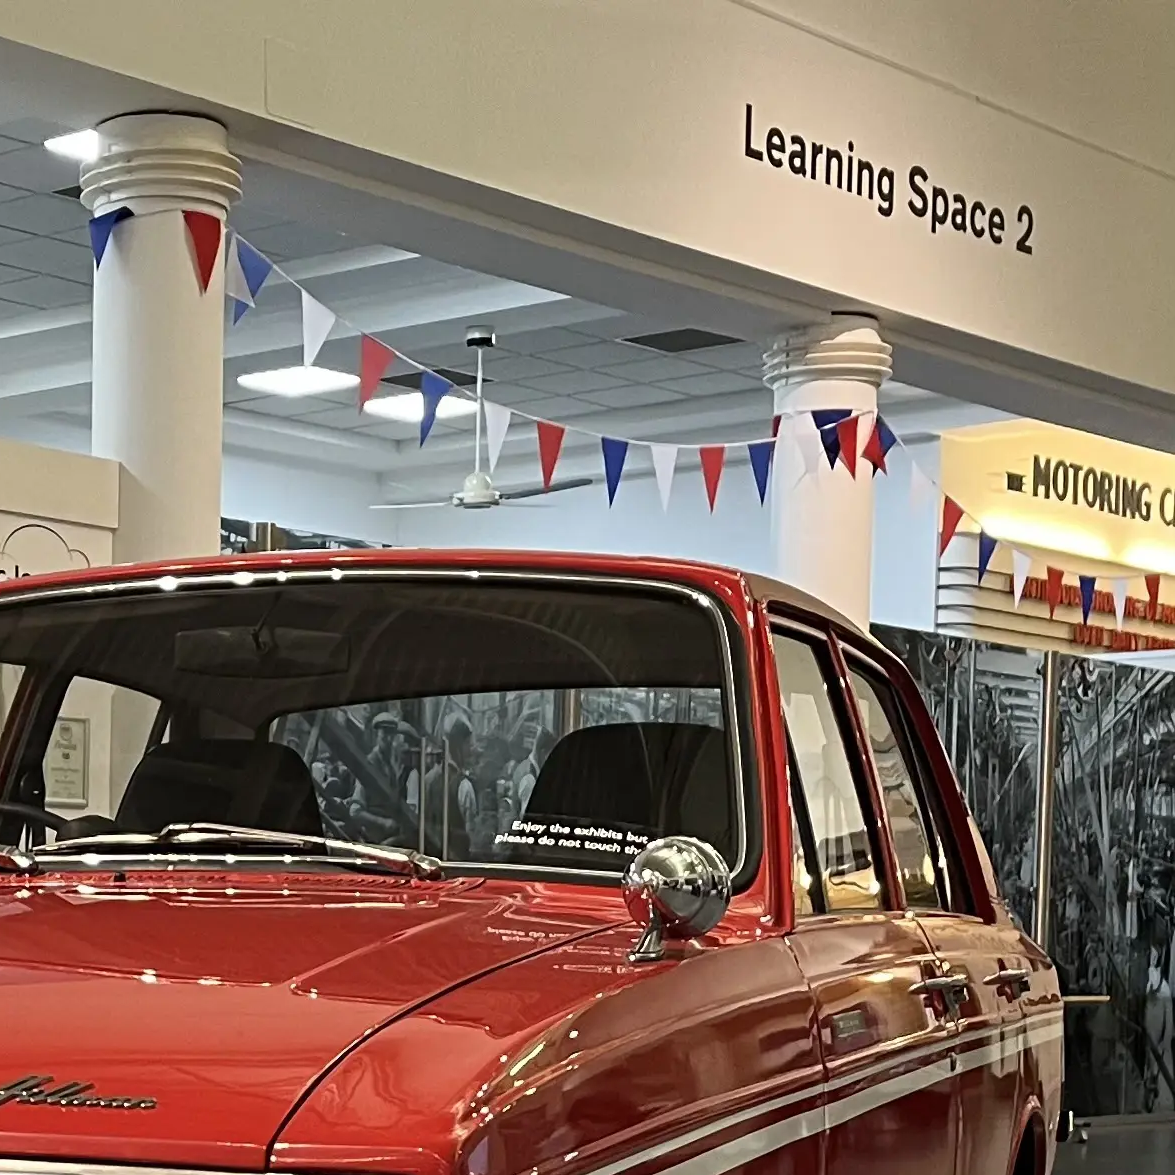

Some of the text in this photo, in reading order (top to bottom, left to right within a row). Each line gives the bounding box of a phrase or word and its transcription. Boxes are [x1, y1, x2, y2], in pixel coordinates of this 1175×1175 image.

[744, 103, 1034, 255] Learning Space 2
[1032, 454, 1153, 522] MOTORING
[494, 832, 535, 845] please
[537, 833, 555, 846] do
[557, 837, 581, 849] not
[584, 840, 621, 853] touch
[511, 820, 649, 845] Enjoy the exhibits but
